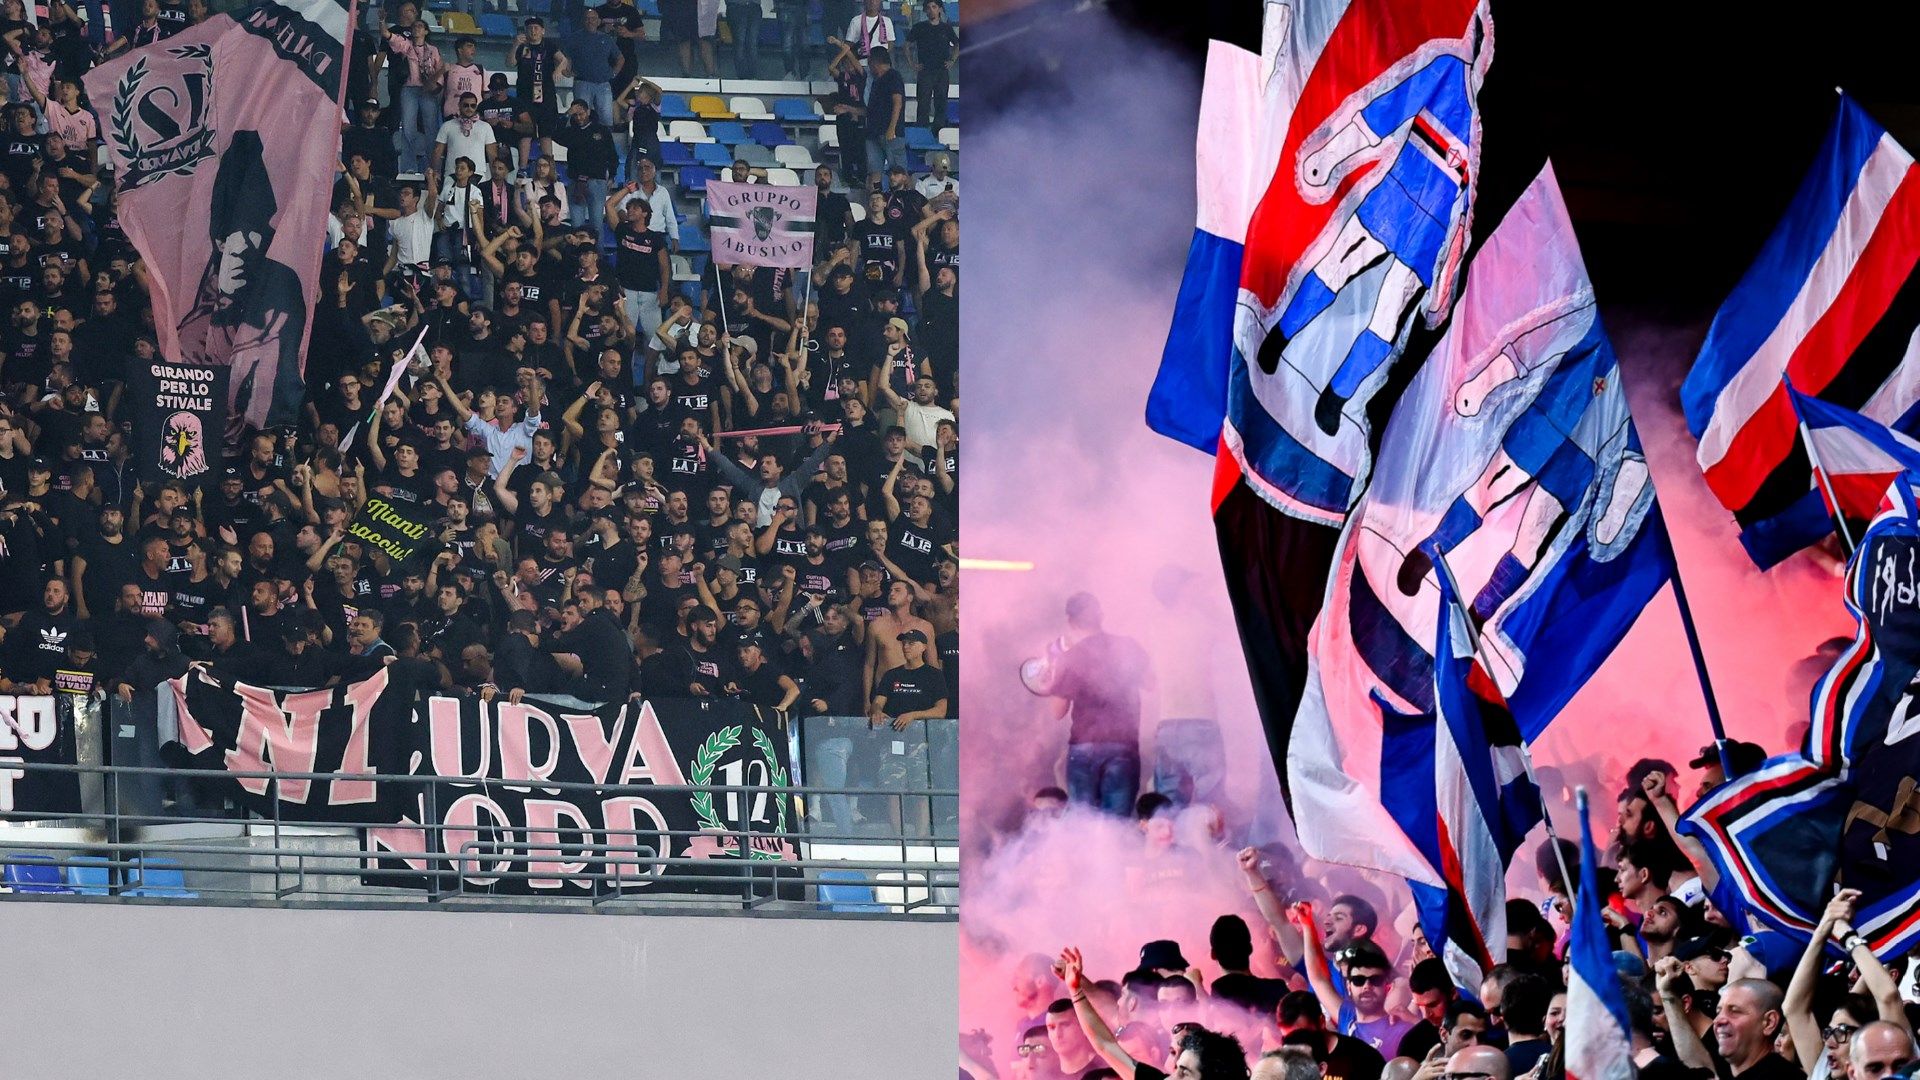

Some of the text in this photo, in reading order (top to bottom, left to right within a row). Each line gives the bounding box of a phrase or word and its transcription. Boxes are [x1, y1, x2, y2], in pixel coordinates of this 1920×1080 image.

[727, 191, 801, 211] GRUPPO
[721, 237, 803, 258] ABUSIVO
[867, 236, 893, 248] LA 12
[526, 288, 540, 300] 12
[151, 364, 215, 382] GIRANDO
[160, 379, 209, 396] PER LO
[156, 394, 213, 411] STIVALE
[696, 397, 708, 408] 12
[672, 459, 689, 472] LA
[367, 499, 428, 540] Nianti
[348, 522, 414, 562] sacciu!
[777, 540, 793, 553] LA
[901, 532, 932, 553] LA 12
[745, 569, 757, 582] 12
[358, 579, 371, 593] 12
[38, 643, 65, 654] adidas
[718, 758, 771, 825] 12
